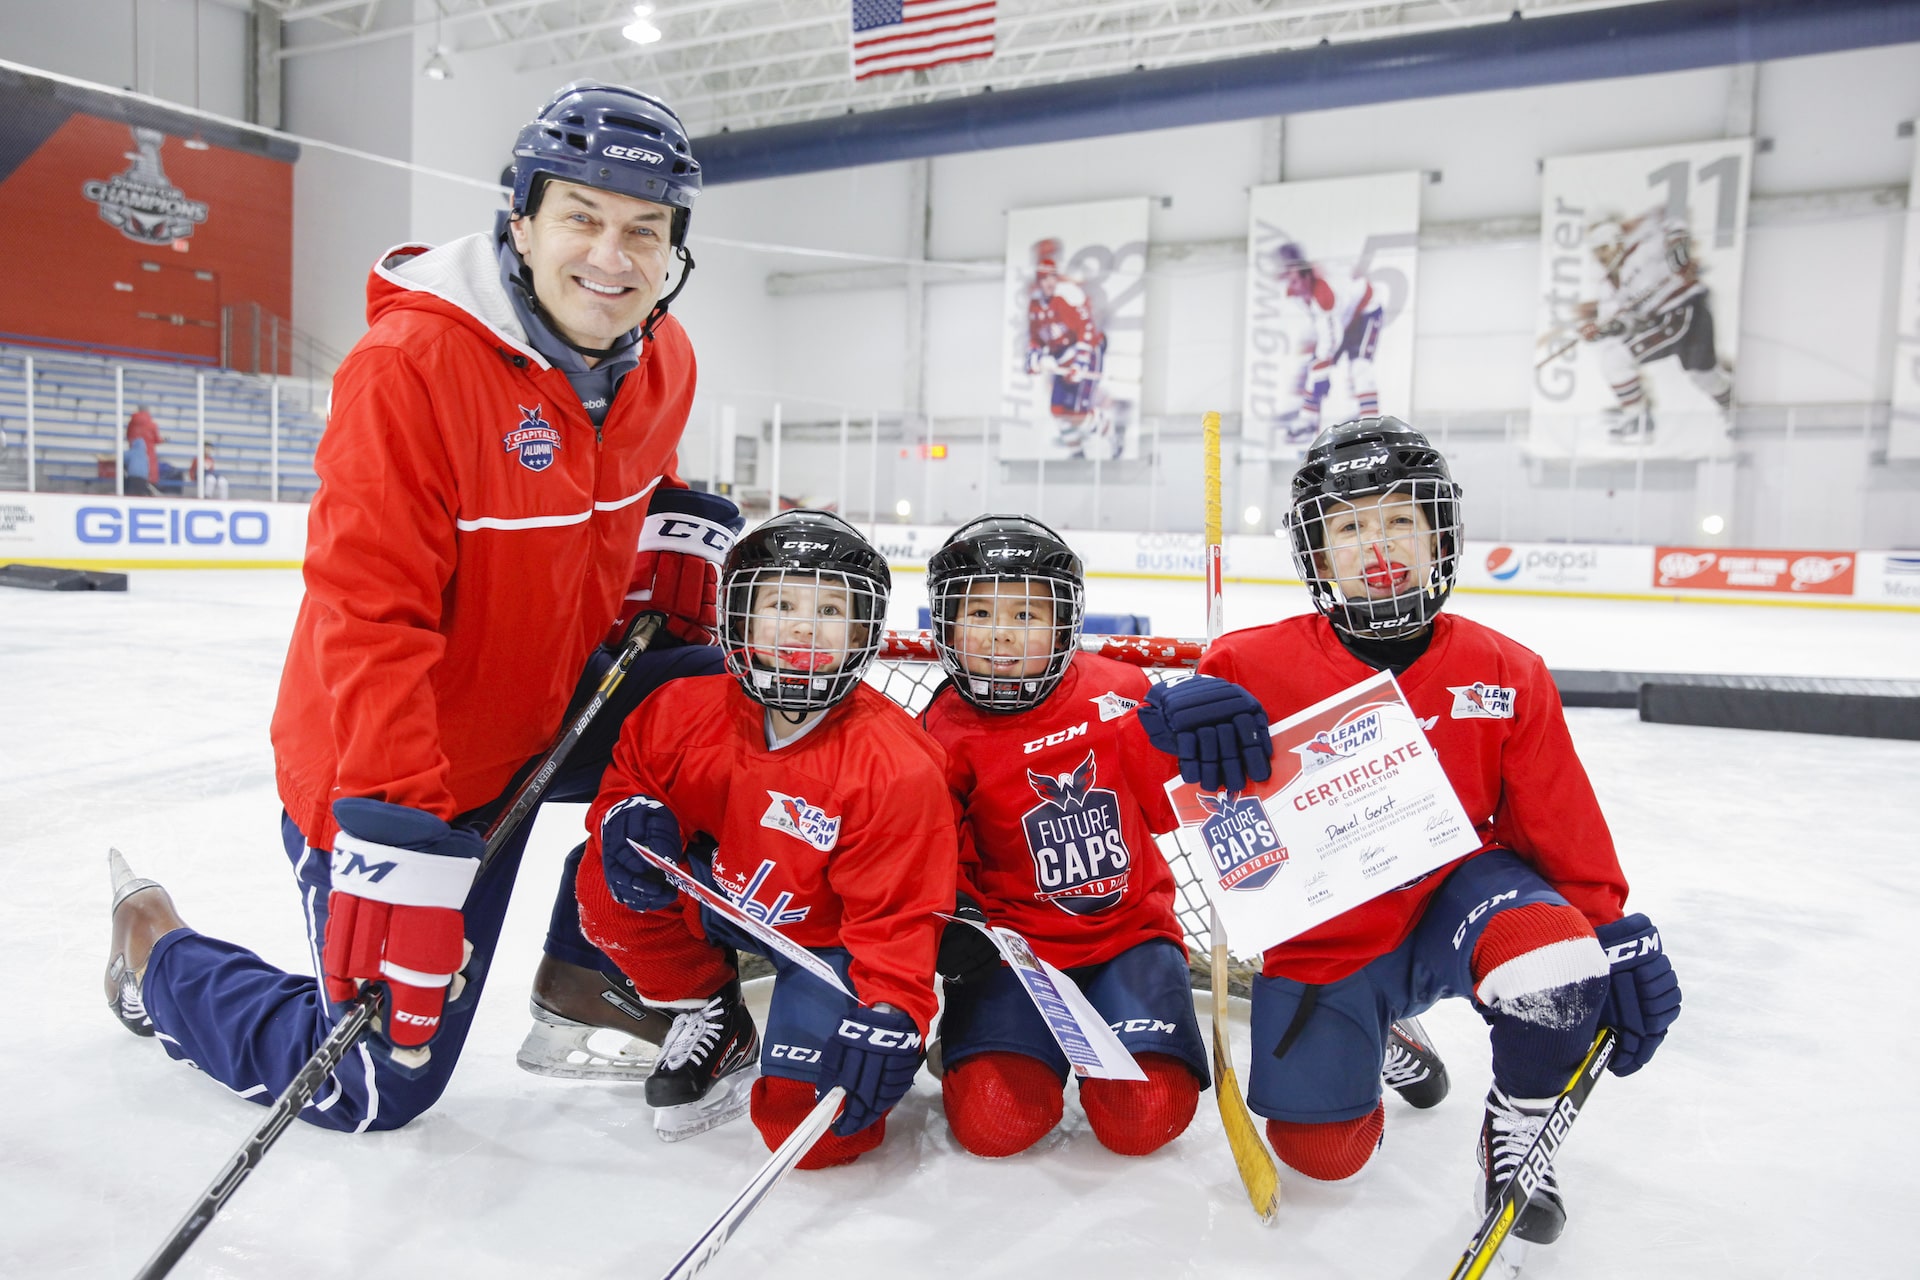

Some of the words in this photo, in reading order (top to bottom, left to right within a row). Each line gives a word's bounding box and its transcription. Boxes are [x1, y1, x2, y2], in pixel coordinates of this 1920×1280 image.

[605, 145, 661, 165] CCM
[84, 181, 207, 222] CHAMPIONS
[1647, 154, 1742, 250] 11
[582, 397, 607, 410] ebok
[513, 429, 557, 442] CAPITALS
[524, 443, 552, 457] ALUMNI
[1330, 455, 1389, 474] CCM
[75, 506, 270, 546] GEICO
[658, 519, 729, 551] CC
[782, 541, 830, 551] CCM
[987, 548, 1034, 558] CCM
[1526, 548, 1598, 573] pepsi
[1369, 613, 1411, 630] CCM
[1117, 699, 1137, 711] ARN
[1023, 722, 1088, 754] CCM
[1331, 714, 1376, 744] LEARN
[1334, 743, 1344, 751] TO
[1343, 726, 1378, 752] PLAY
[538, 760, 557, 788] GREEN
[1293, 740, 1422, 812] CERTIFICATE
[1328, 796, 1339, 807] OF
[1342, 768, 1400, 800] COMPLETION
[603, 796, 665, 828] CM
[803, 808, 837, 833] LERN
[1038, 804, 1111, 847] FUTURE
[1209, 806, 1259, 844] FUTURE
[1325, 813, 1359, 841] Daniel
[1364, 795, 1396, 821] Gerst
[809, 824, 835, 846] PAY
[1211, 820, 1275, 871] CAPS
[1036, 828, 1129, 888] CAPS
[1220, 865, 1248, 889] LEARN
[1249, 858, 1262, 870] TO
[1264, 848, 1287, 864] PLAY
[1452, 889, 1518, 951] CCM
[1603, 931, 1659, 966] CM
[838, 1018, 921, 1051] CCM
[719, 1038, 738, 1069] CCM
[1590, 1034, 1616, 1079] PRODIGY
[1494, 1216, 1509, 1238] FLEX
